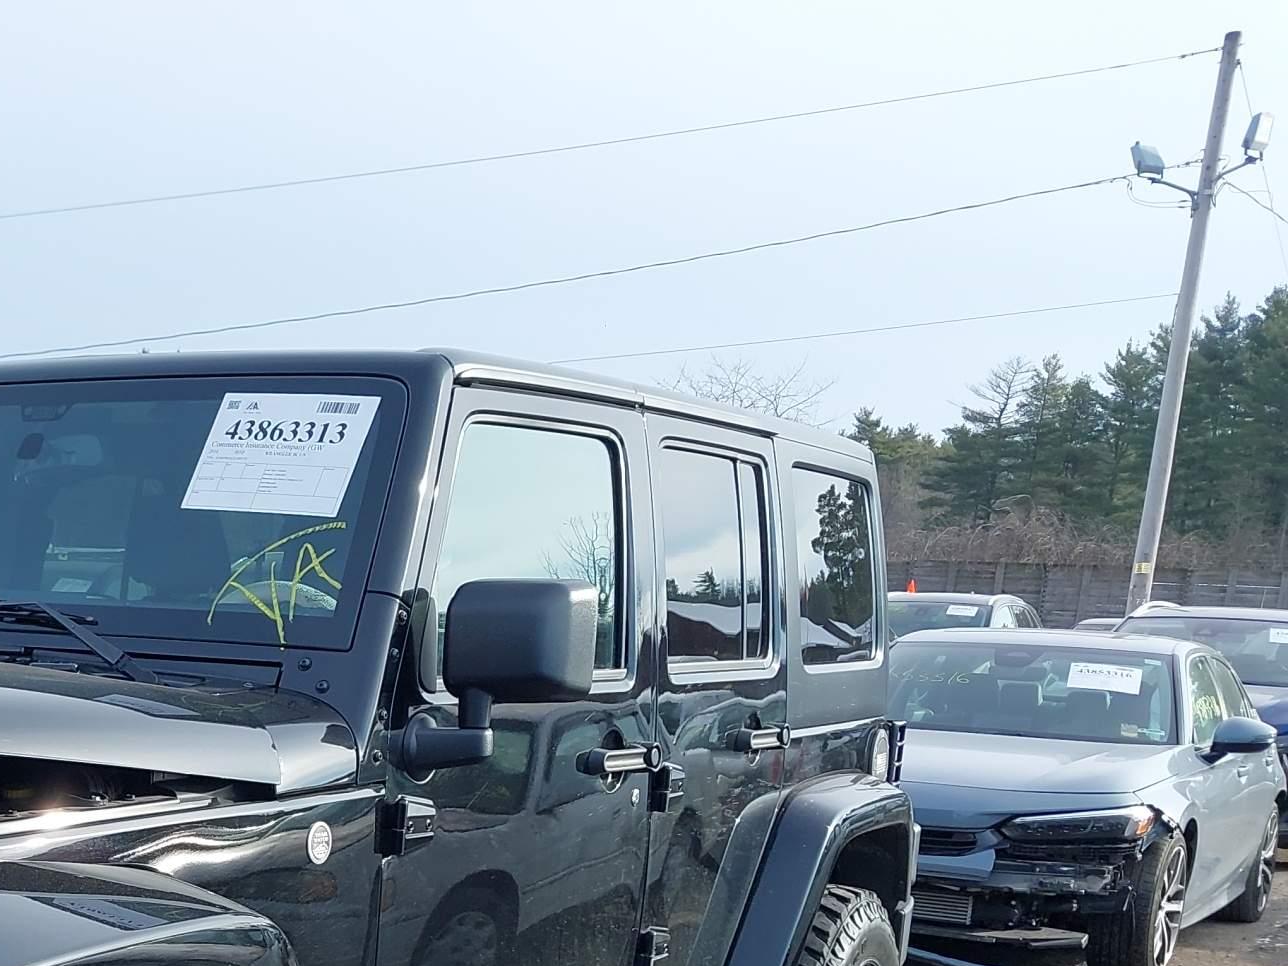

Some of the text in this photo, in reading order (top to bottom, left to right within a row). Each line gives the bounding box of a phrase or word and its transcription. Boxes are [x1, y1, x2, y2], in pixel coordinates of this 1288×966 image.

[225, 419, 348, 444] 43863313
[211, 441, 245, 449] Commerce
[245, 442, 275, 450] Insurance
[276, 442, 306, 451] Company
